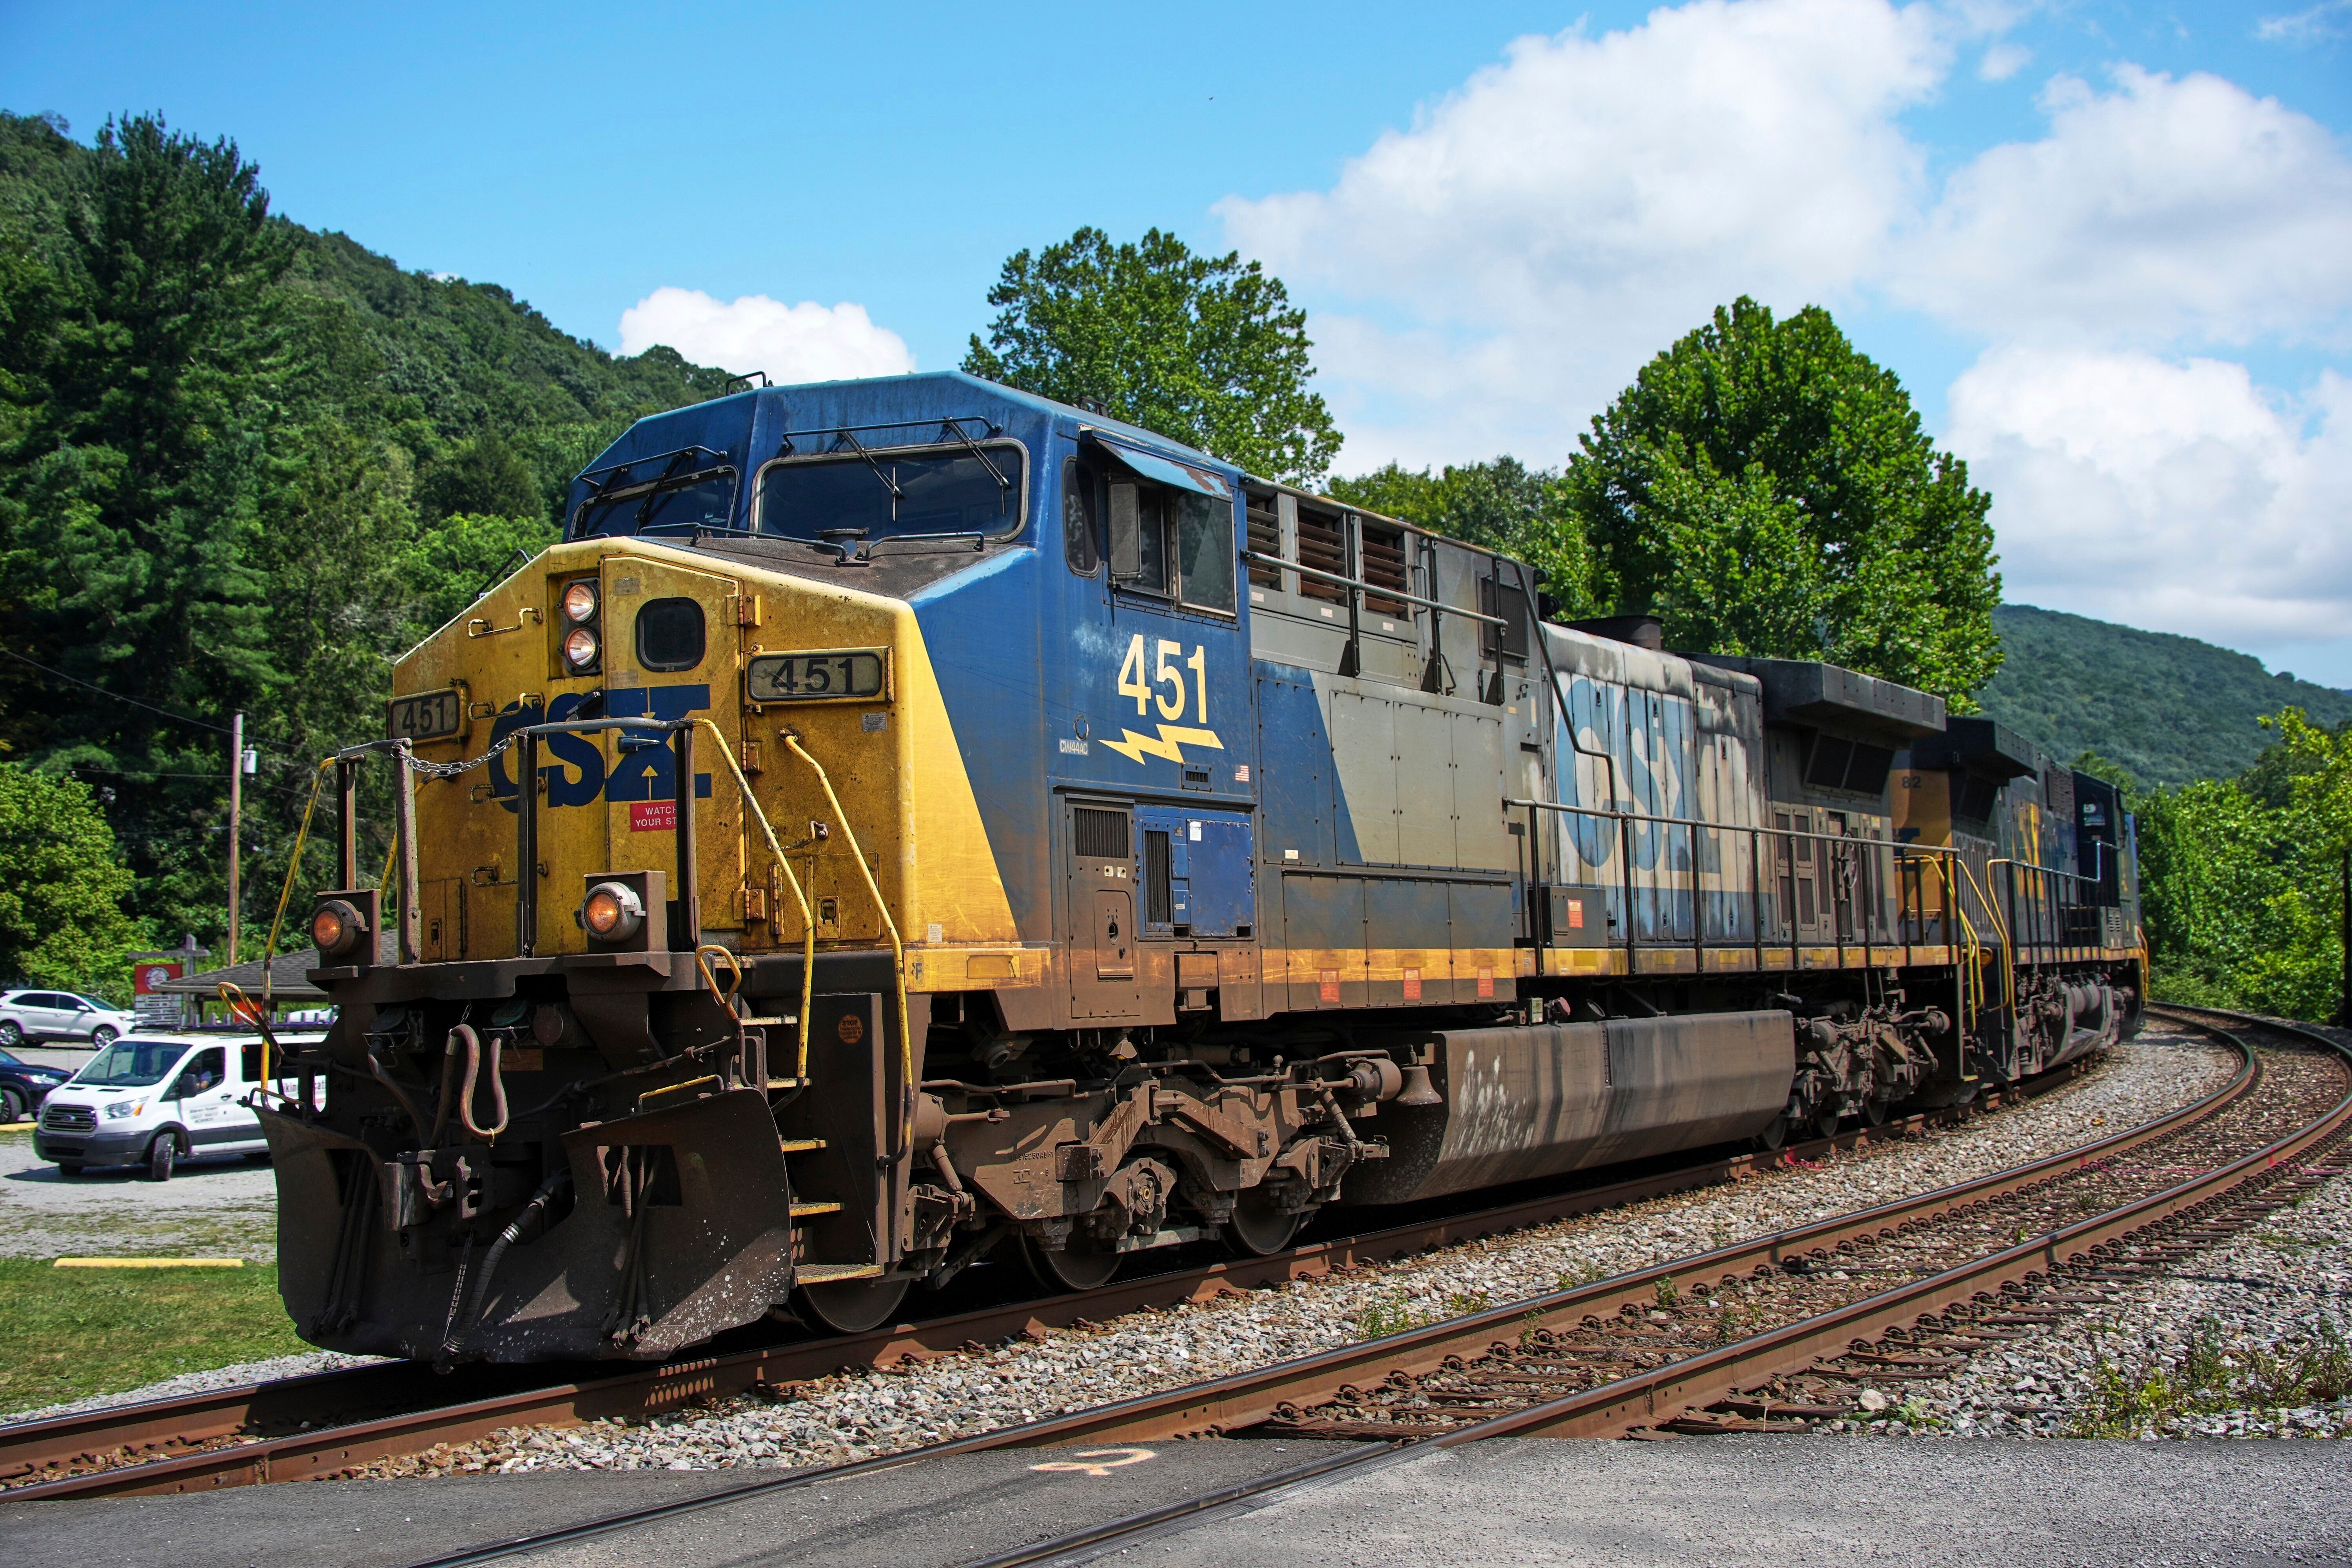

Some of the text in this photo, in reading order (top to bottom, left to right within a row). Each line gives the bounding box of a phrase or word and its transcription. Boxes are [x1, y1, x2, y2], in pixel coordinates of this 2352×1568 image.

[771, 658, 853, 694] 451
[1118, 633, 1207, 724] 451
[402, 697, 445, 735] 451
[488, 684, 712, 814] CSX
[1060, 740, 1088, 755] CW44AC
[1556, 678, 1721, 874] CSX
[635, 818, 661, 827] YOUR
[916, 962, 922, 980] F
